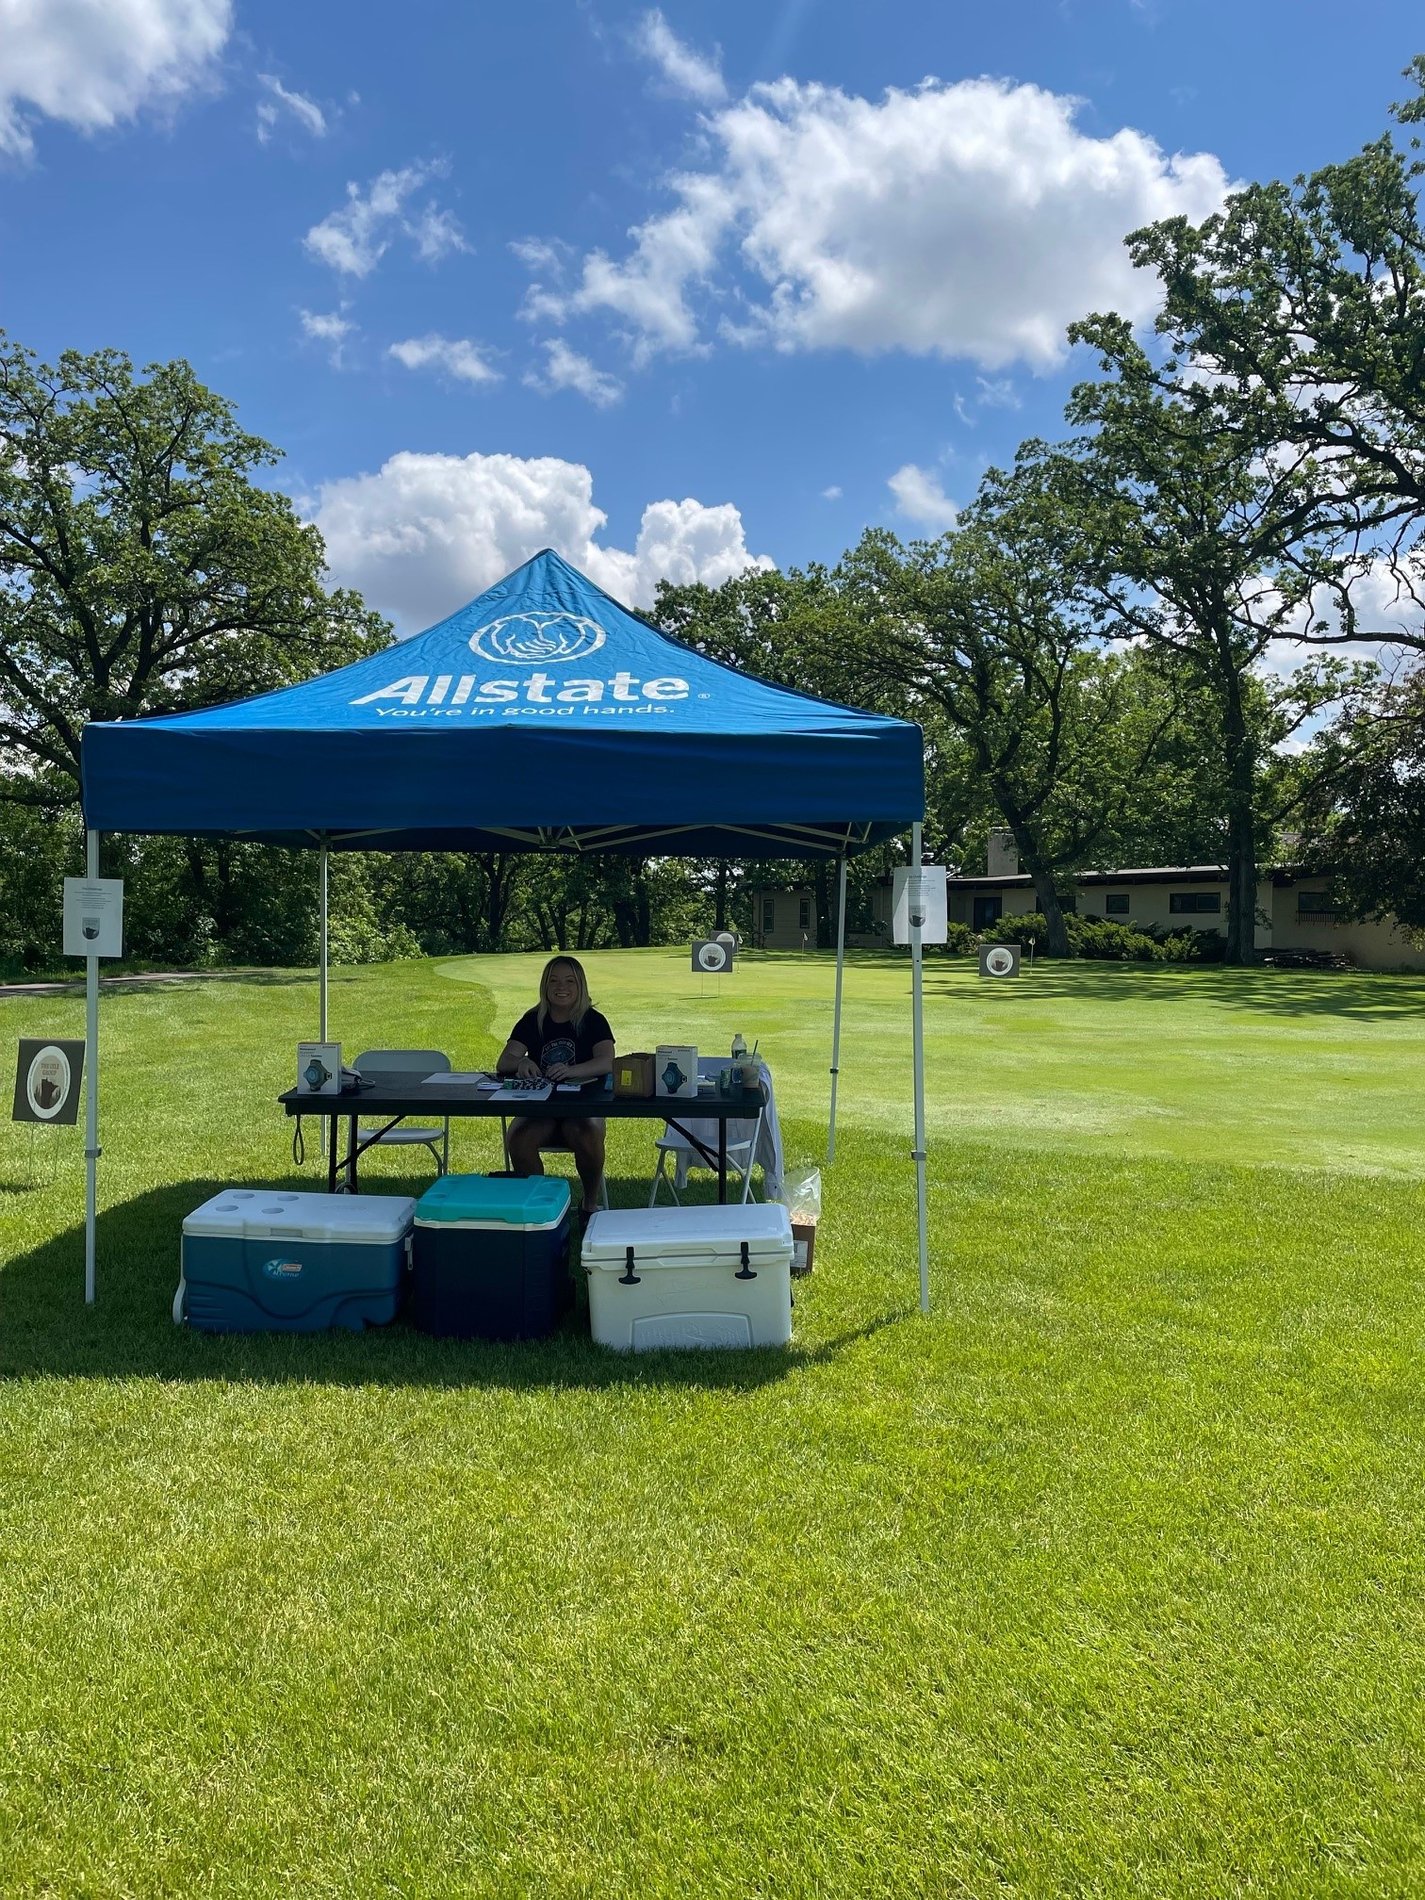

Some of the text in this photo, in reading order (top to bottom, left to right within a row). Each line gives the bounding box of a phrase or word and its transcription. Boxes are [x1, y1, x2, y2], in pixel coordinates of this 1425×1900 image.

[348, 671, 690, 704] Allstate
[375, 704, 675, 717] You're in good hands.
